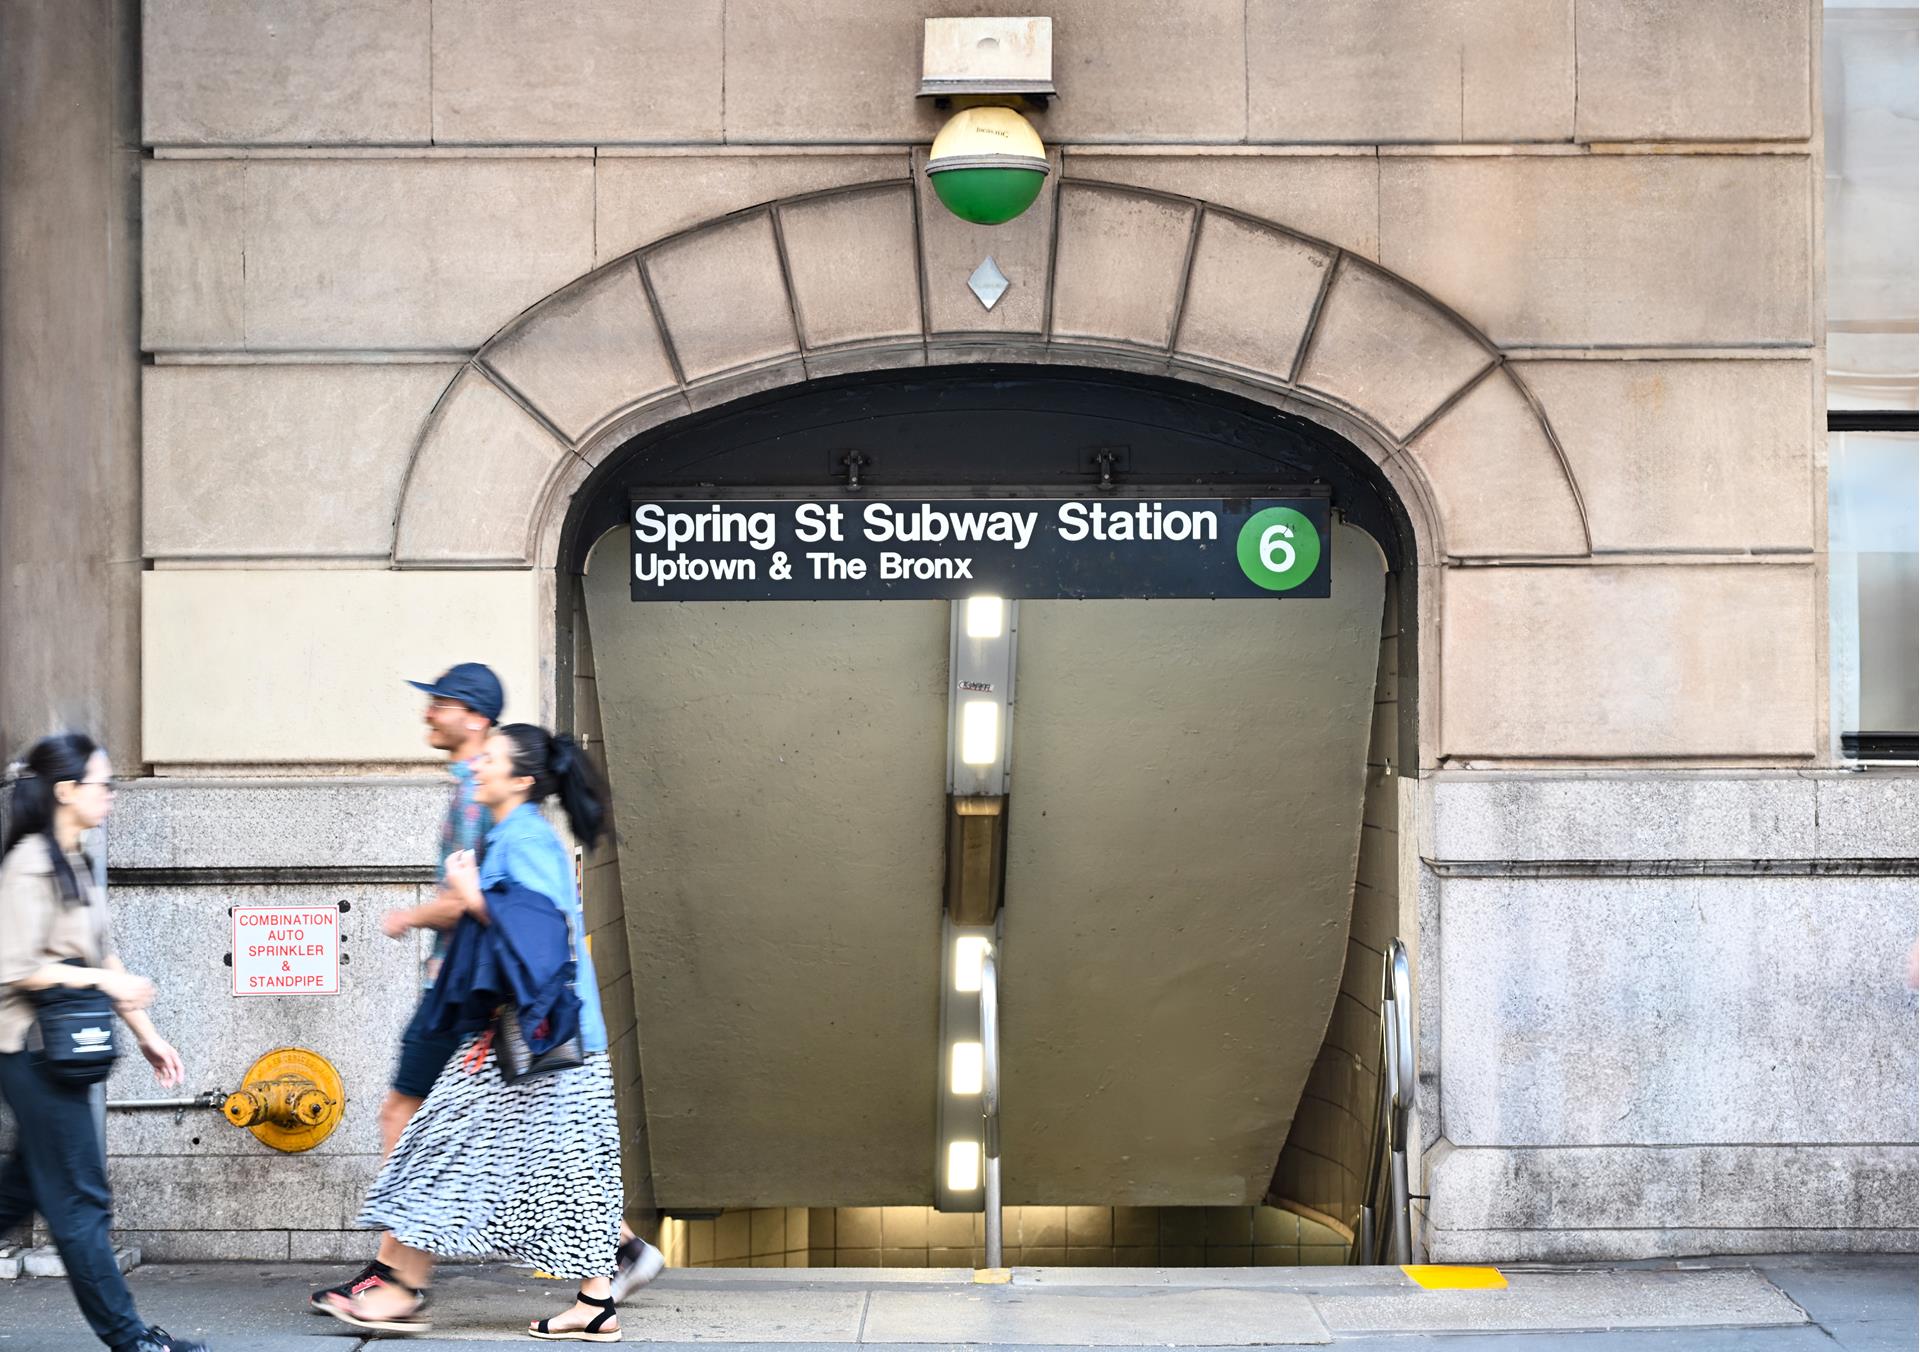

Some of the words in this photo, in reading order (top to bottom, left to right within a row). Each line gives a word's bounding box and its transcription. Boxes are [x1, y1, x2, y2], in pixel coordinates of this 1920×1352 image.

[635, 503, 775, 551] Spring
[795, 503, 844, 542] St
[863, 503, 1038, 550] Subway
[1058, 502, 1218, 541] Station
[1259, 525, 1296, 573] 6
[635, 553, 756, 586] Uptown
[769, 551, 792, 580] &
[806, 552, 867, 580] The
[880, 552, 973, 580] Bronx
[239, 914, 333, 926] COMBINATION
[268, 929, 304, 941] AUTO
[248, 945, 324, 957] SPRINKLER
[281, 960, 290, 971] &
[249, 975, 324, 988] STANDPIPE
